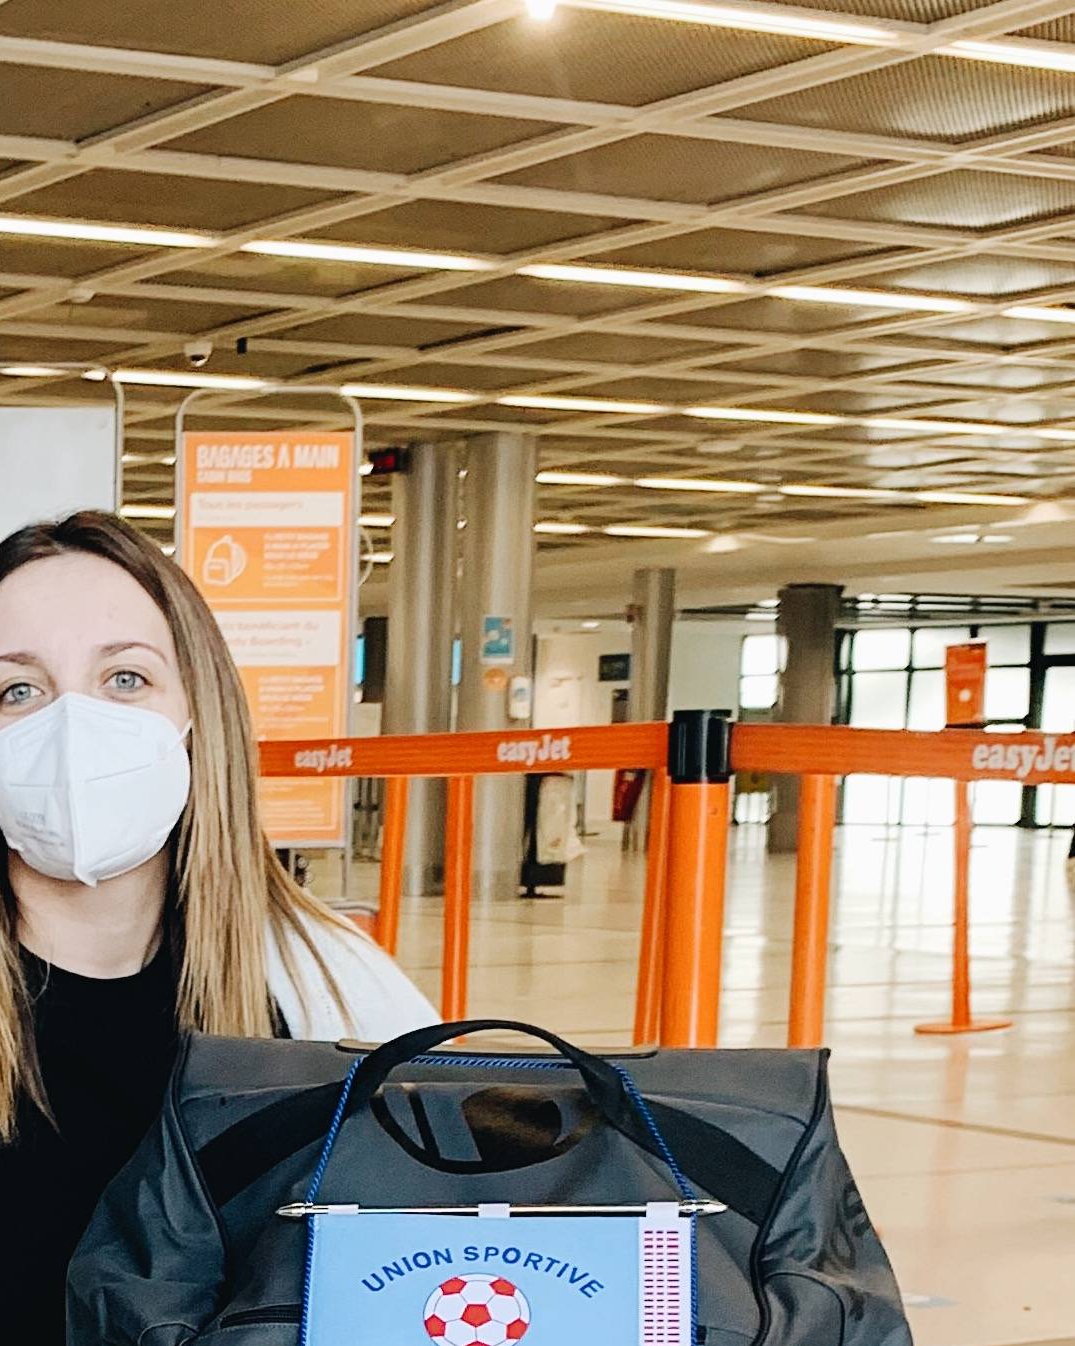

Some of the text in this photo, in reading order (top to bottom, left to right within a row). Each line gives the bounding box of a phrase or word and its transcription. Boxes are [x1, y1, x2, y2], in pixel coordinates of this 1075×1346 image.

[197, 444, 274, 469] BAGAGES
[294, 444, 340, 469] MAIN
[294, 744, 353, 773] easyJet
[497, 734, 572, 767] easyJet
[361, 1246, 604, 1298] UNION SPORTIVE
